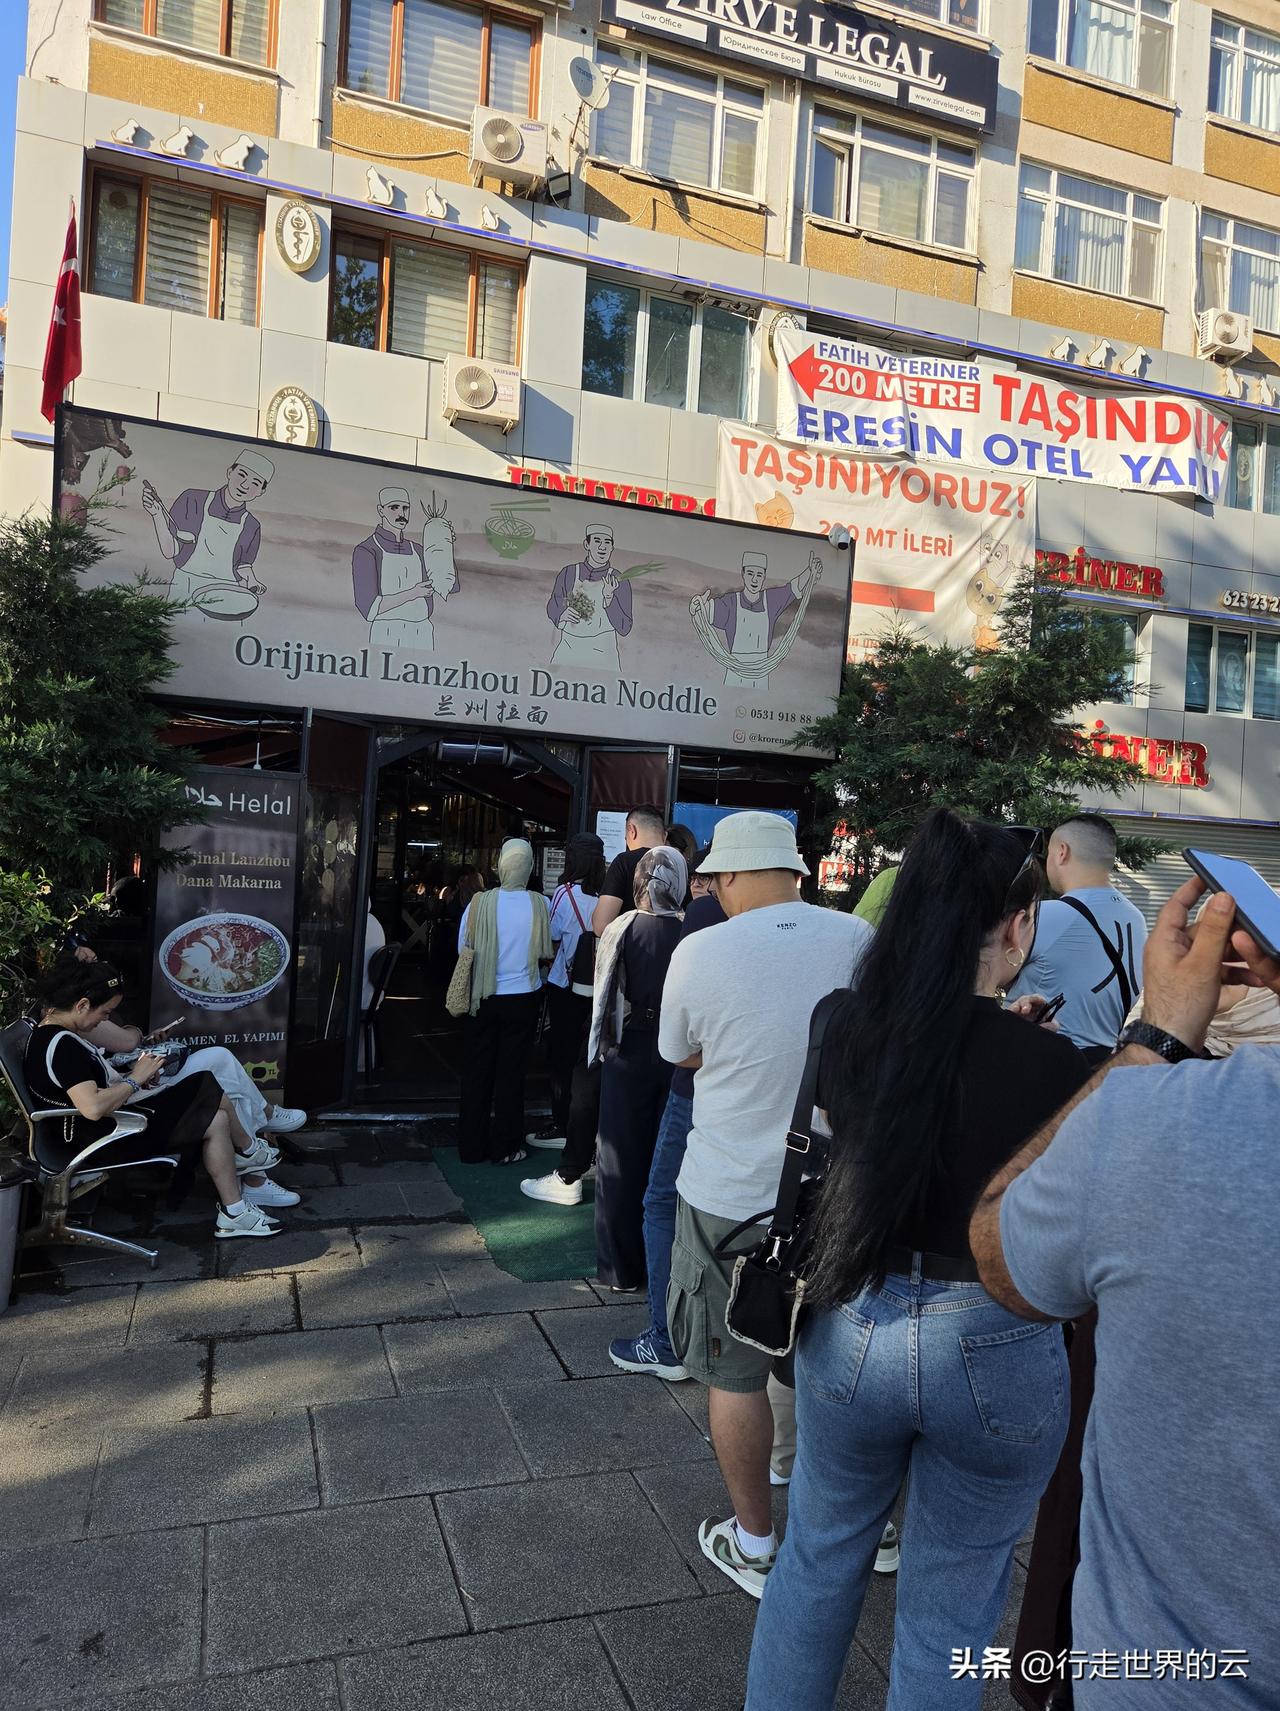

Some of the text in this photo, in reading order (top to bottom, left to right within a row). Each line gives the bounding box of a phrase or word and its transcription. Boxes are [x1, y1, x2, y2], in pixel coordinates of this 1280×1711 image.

[641, 10, 683, 29] Law Office
[723, 35, 802, 65] Юридическое Бюро
[807, 14, 943, 85] LEGAL
[834, 68, 857, 82] Hukuk
[914, 92, 982, 118] www.zirvelegal.com
[818, 340, 981, 382] FATİH VETERİNER
[818, 364, 976, 409] 200 METRE
[993, 373, 1229, 463] TAŞINDIK
[796, 403, 963, 459] ERESİN
[983, 433, 1093, 479] OTEL
[730, 436, 1026, 520] TAŞINIYORUZ!
[866, 527, 898, 549] MT
[903, 527, 953, 557] İLERİ
[1223, 590, 1280, 613] 623 23 2
[235, 635, 718, 716] Orijinal Lanzhou Dana Noddle
[433, 694, 549, 726] 兰州拉面
[750, 708, 774, 721] 0531
[778, 711, 797, 723] 918
[799, 713, 812, 725] 88
[229, 792, 291, 815] Helal
[230, 851, 291, 868] Lanzhou
[175, 874, 283, 890] Dana Makarna
[224, 1034, 240, 1044] EL
[243, 1031, 286, 1043] YAPIMI
